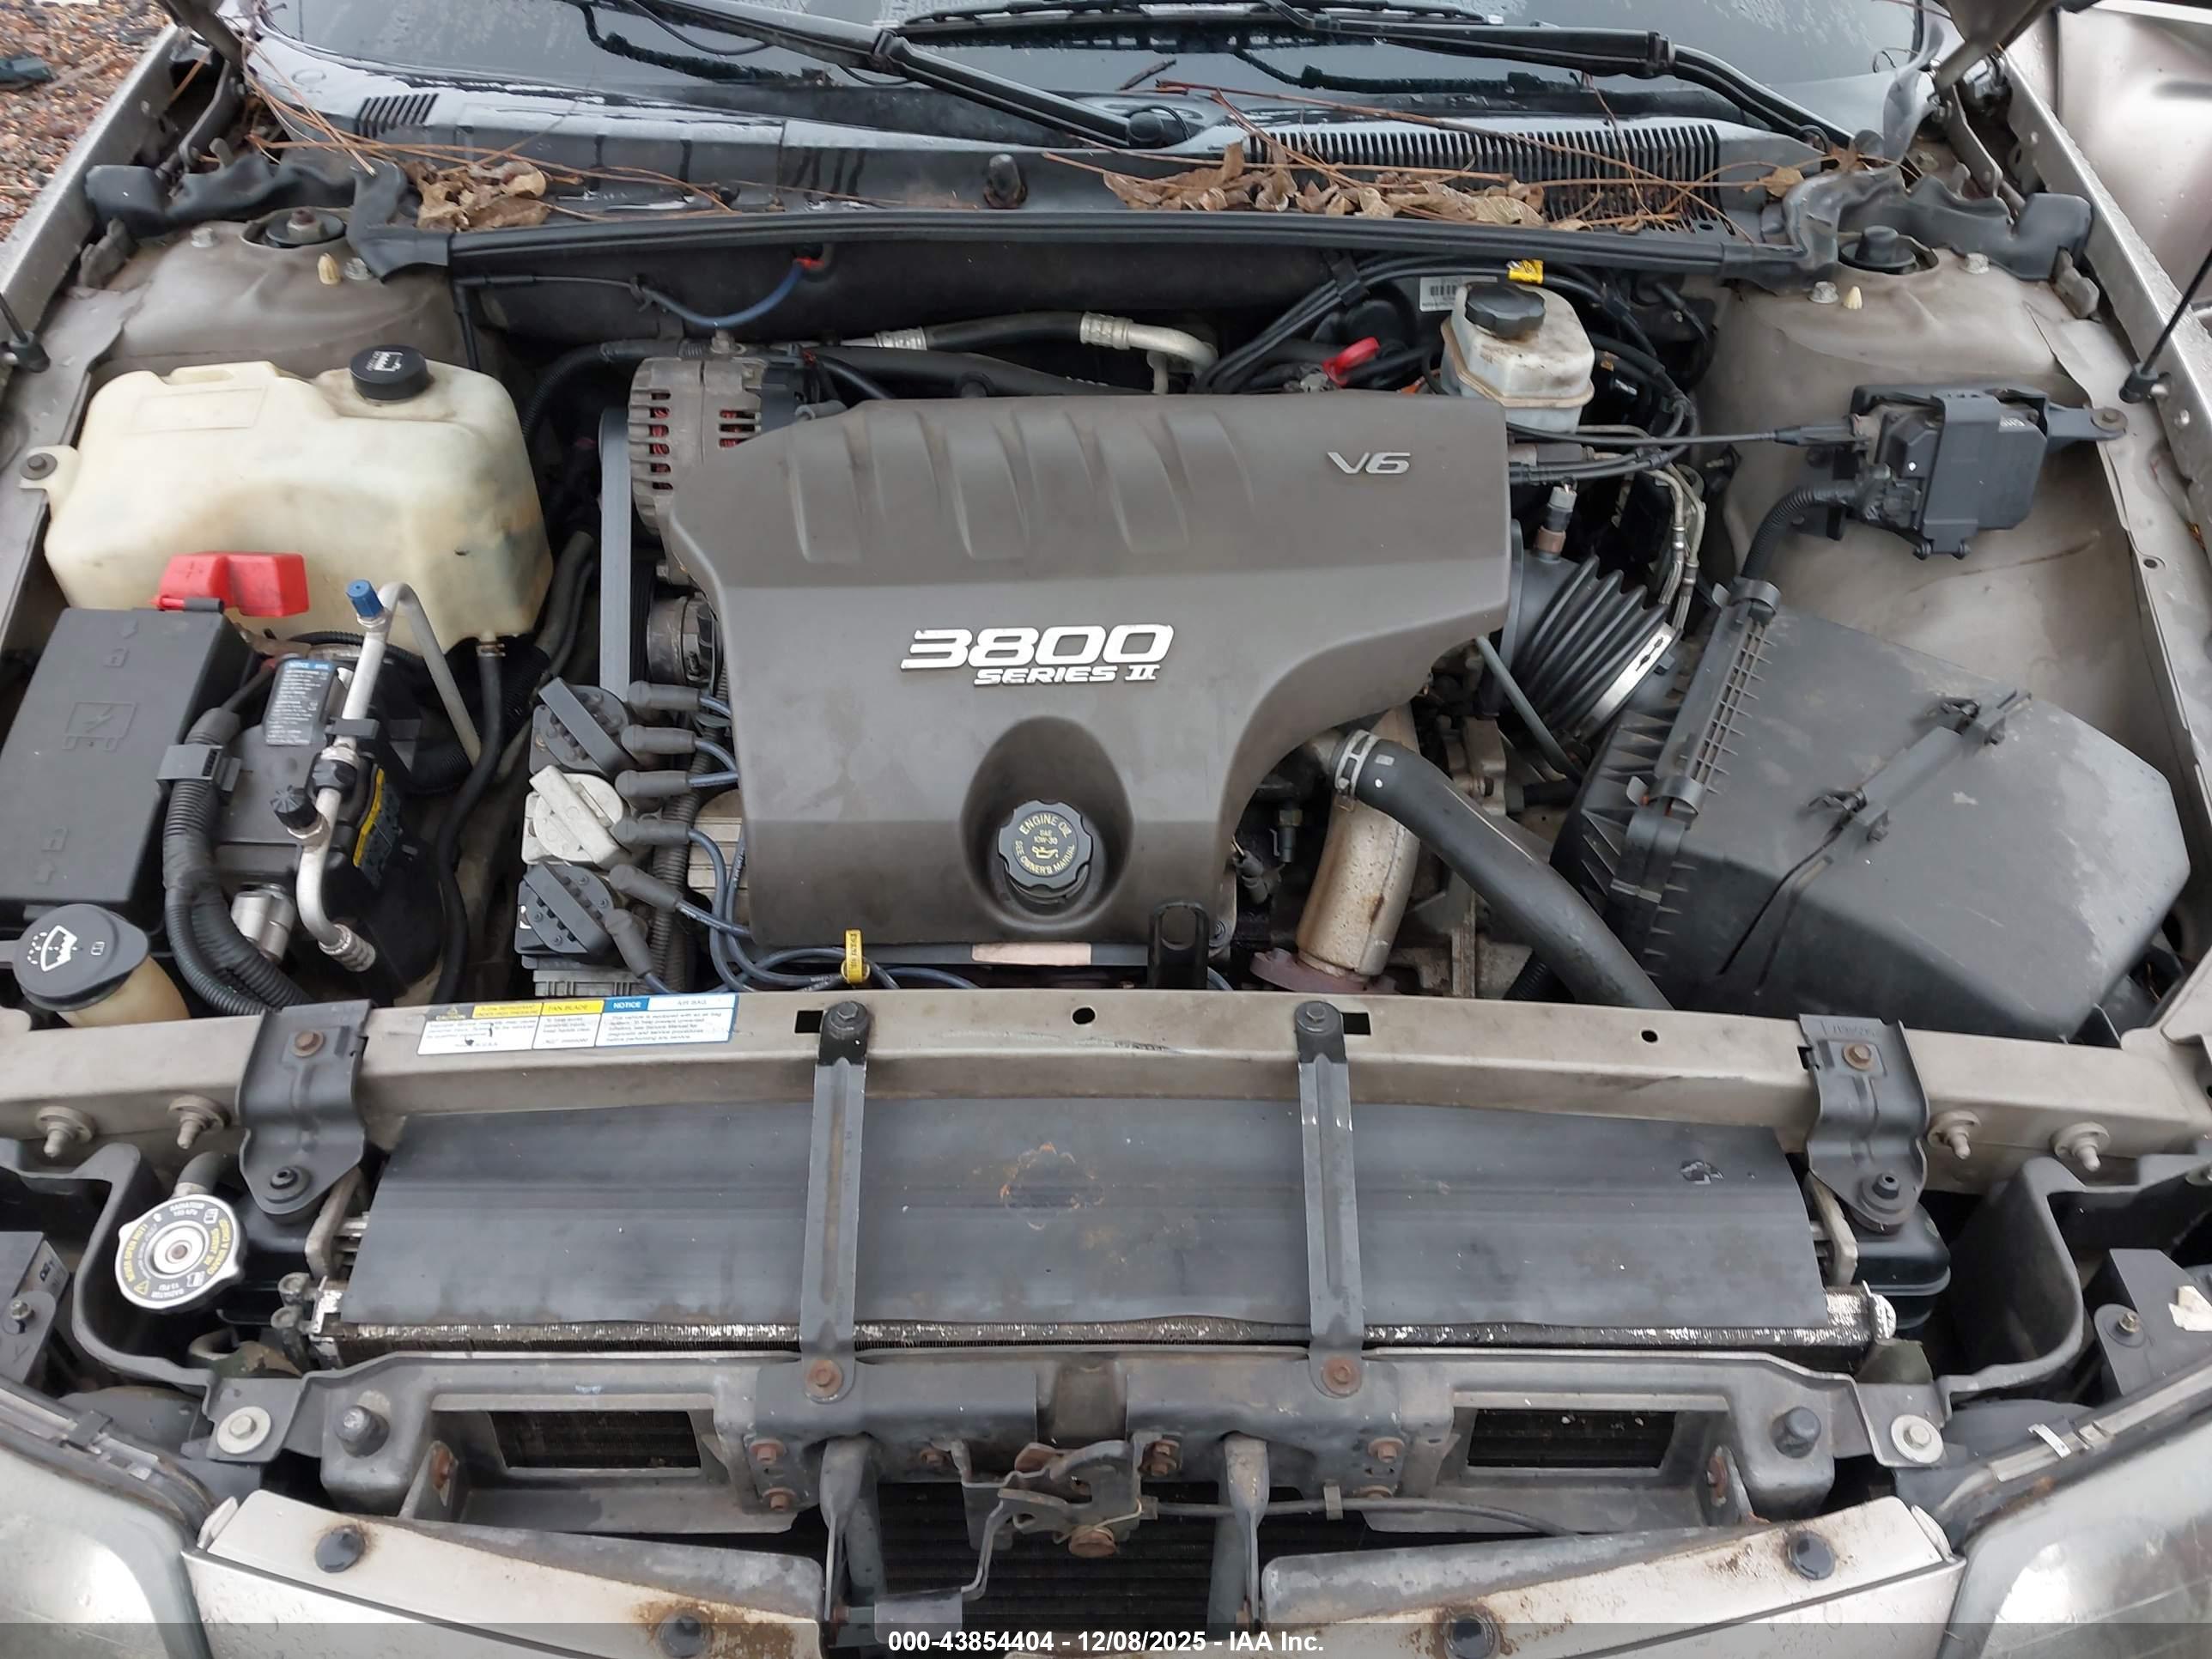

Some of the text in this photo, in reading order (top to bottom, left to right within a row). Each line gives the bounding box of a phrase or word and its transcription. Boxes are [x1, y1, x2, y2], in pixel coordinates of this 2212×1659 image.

[1327, 452, 1411, 474] V6
[901, 624, 1175, 669] 3800
[974, 664, 1160, 685] SERIES II
[1018, 813, 1073, 838] ENGINE OIL
[1053, 844, 1075, 873] MANUAL
[613, 1000, 642, 1010] NOTICE
